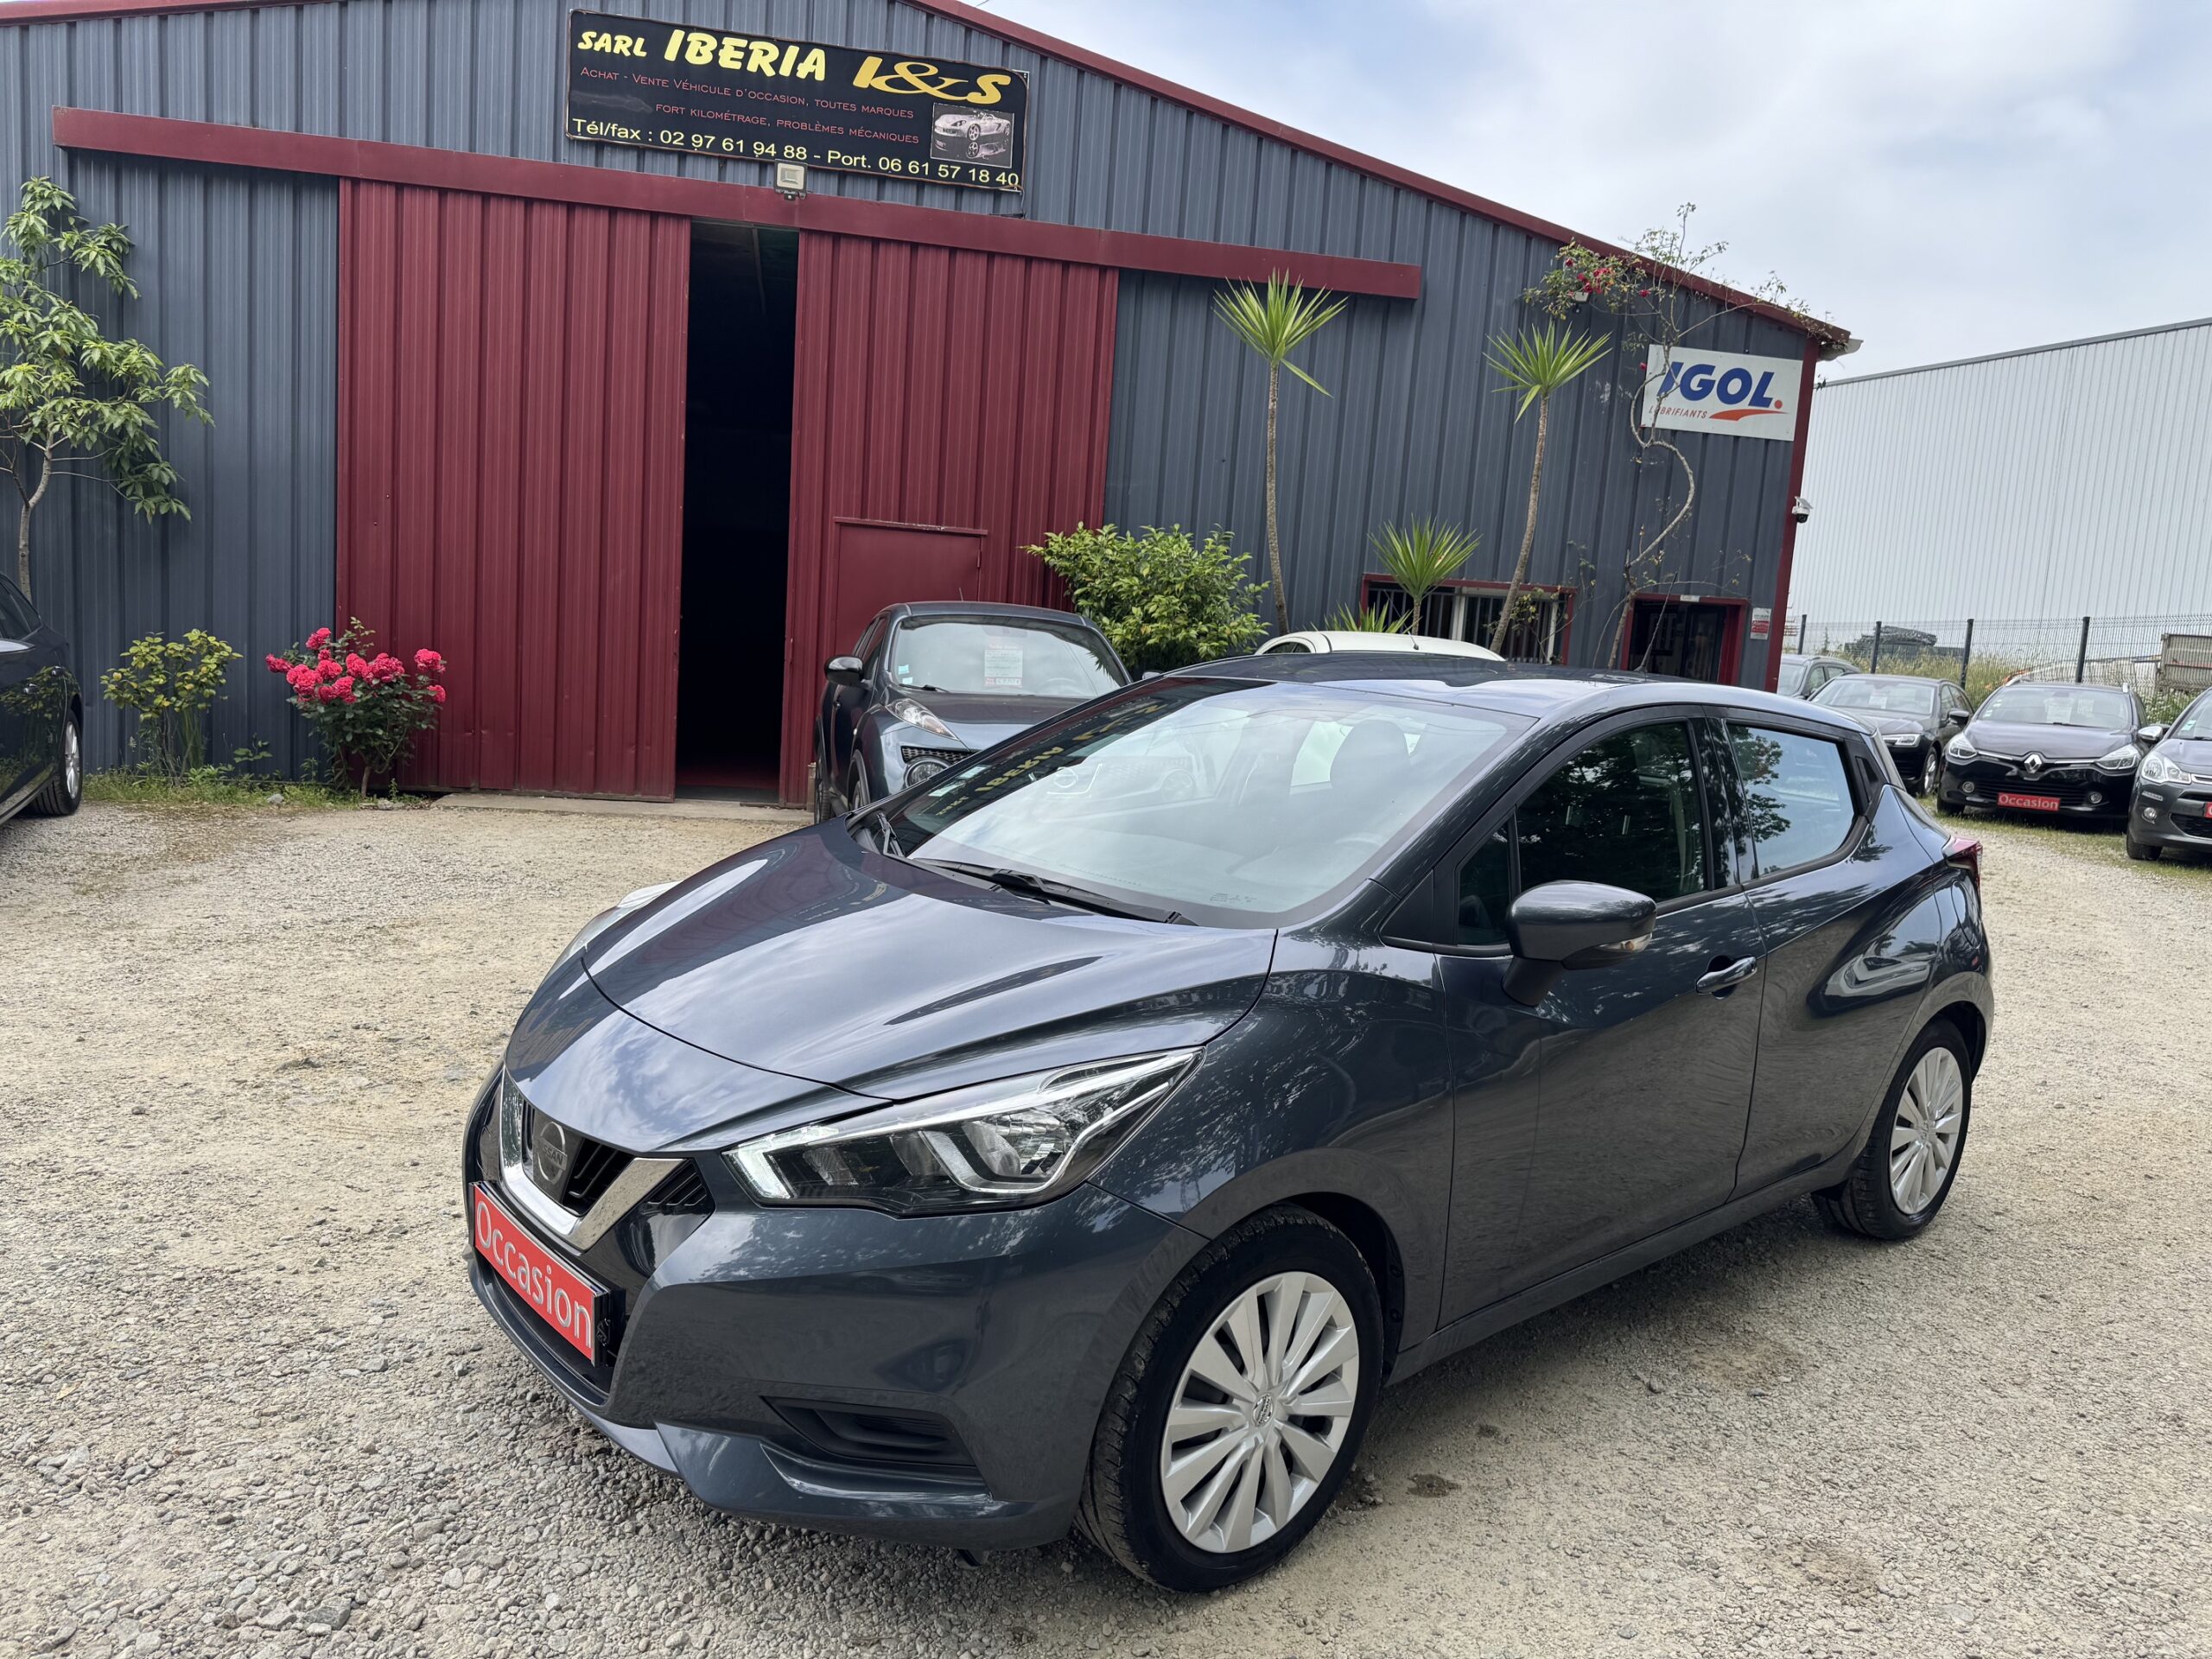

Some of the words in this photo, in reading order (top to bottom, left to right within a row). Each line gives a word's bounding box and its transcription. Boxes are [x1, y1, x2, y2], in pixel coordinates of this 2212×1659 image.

[577, 31, 647, 57] SARL
[664, 29, 826, 81] IBERIA
[656, 104, 685, 115] FORT
[690, 108, 771, 127] KILOMÉTRAGE,
[776, 119, 844, 135] PROBLÈMES
[849, 126, 919, 144] MÉCANIQUES
[814, 99, 857, 111] TOUTES
[861, 105, 914, 118] MARQUES
[572, 118, 641, 141] Tél/fax
[659, 130, 685, 146] 02
[690, 134, 716, 149] 97
[721, 137, 744, 153] 61
[753, 141, 776, 157] 94
[783, 144, 808, 161] 88
[827, 149, 871, 168] Port.
[878, 156, 902, 172] 06
[908, 160, 929, 176] 61
[938, 164, 961, 179] 57
[969, 168, 990, 183] 18
[995, 171, 1019, 186] 40
[1648, 405, 1708, 419] LBRIFIANTS
[1999, 794, 2059, 810] Occasion
[477, 1200, 592, 1349] Occasion
